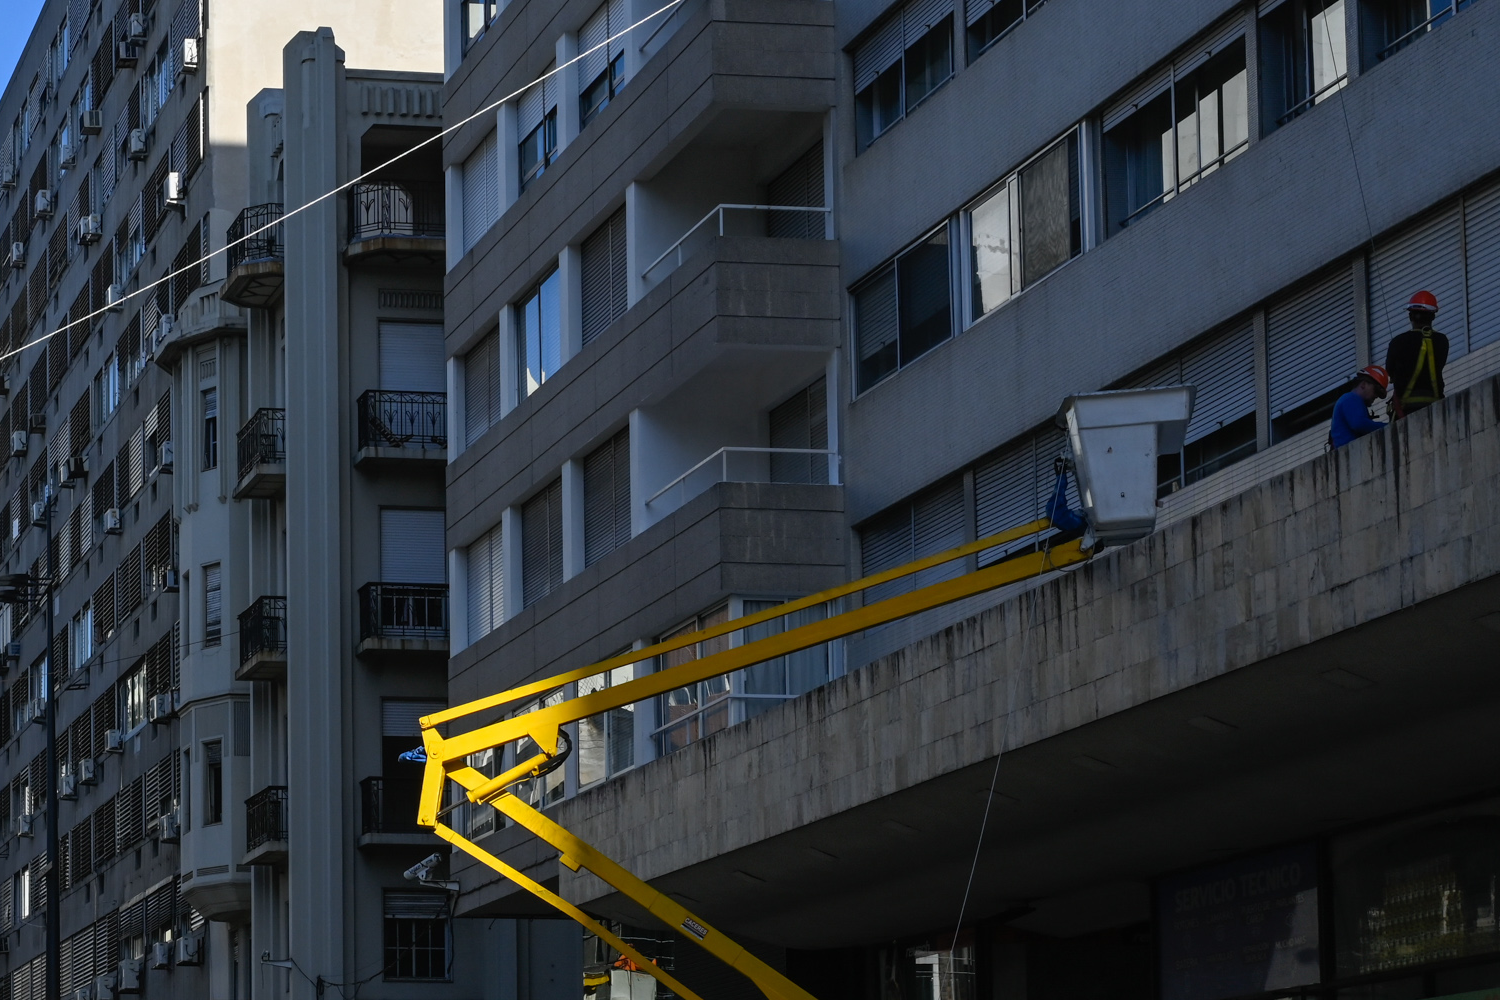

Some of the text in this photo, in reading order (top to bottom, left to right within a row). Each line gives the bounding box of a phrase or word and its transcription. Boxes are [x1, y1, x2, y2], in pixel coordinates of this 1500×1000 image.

[1174, 862, 1301, 914] SERVICIO TECNICO
[684, 917, 708, 935] CACERES
